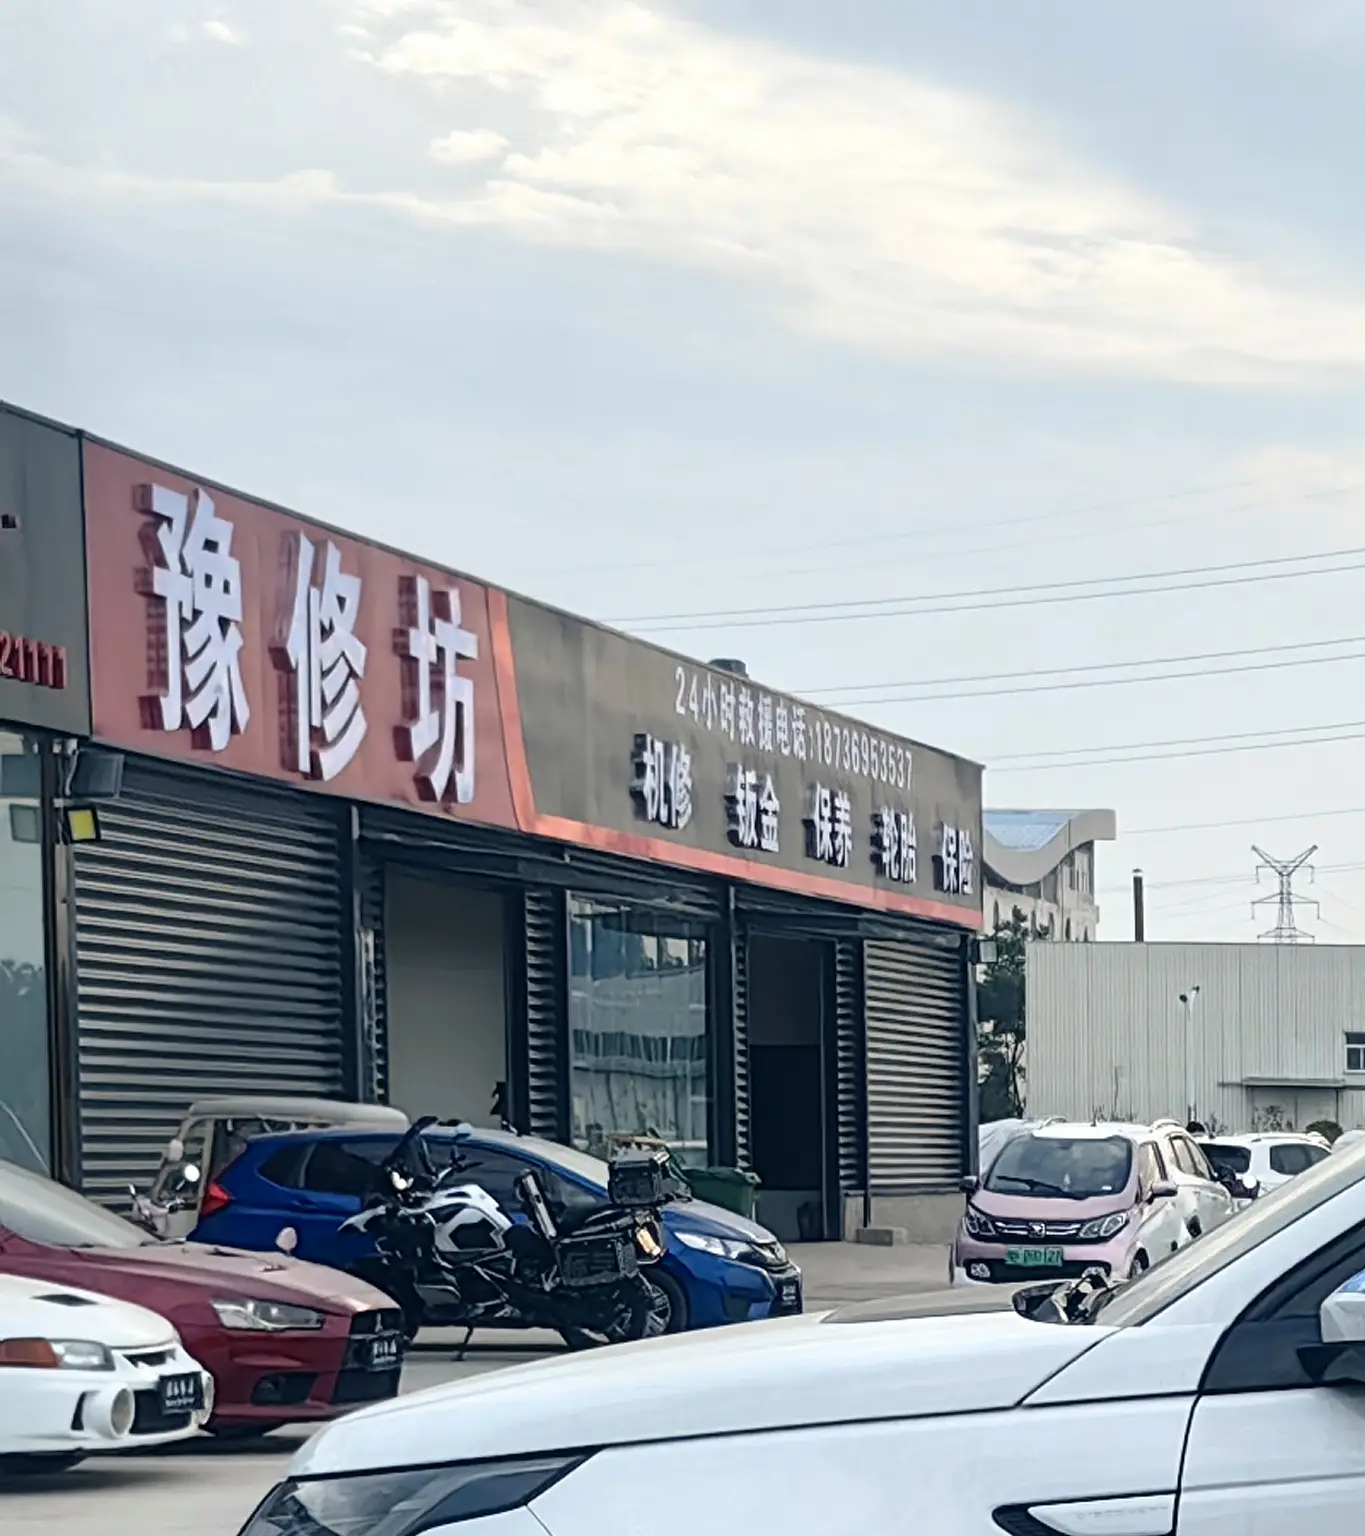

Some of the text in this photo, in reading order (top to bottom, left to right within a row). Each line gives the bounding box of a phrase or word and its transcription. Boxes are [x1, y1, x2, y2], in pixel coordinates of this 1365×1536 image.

[142, 481, 481, 804] 豫修坊
[642, 733, 974, 895] 机修 钣金 保养 轮胎 保险
